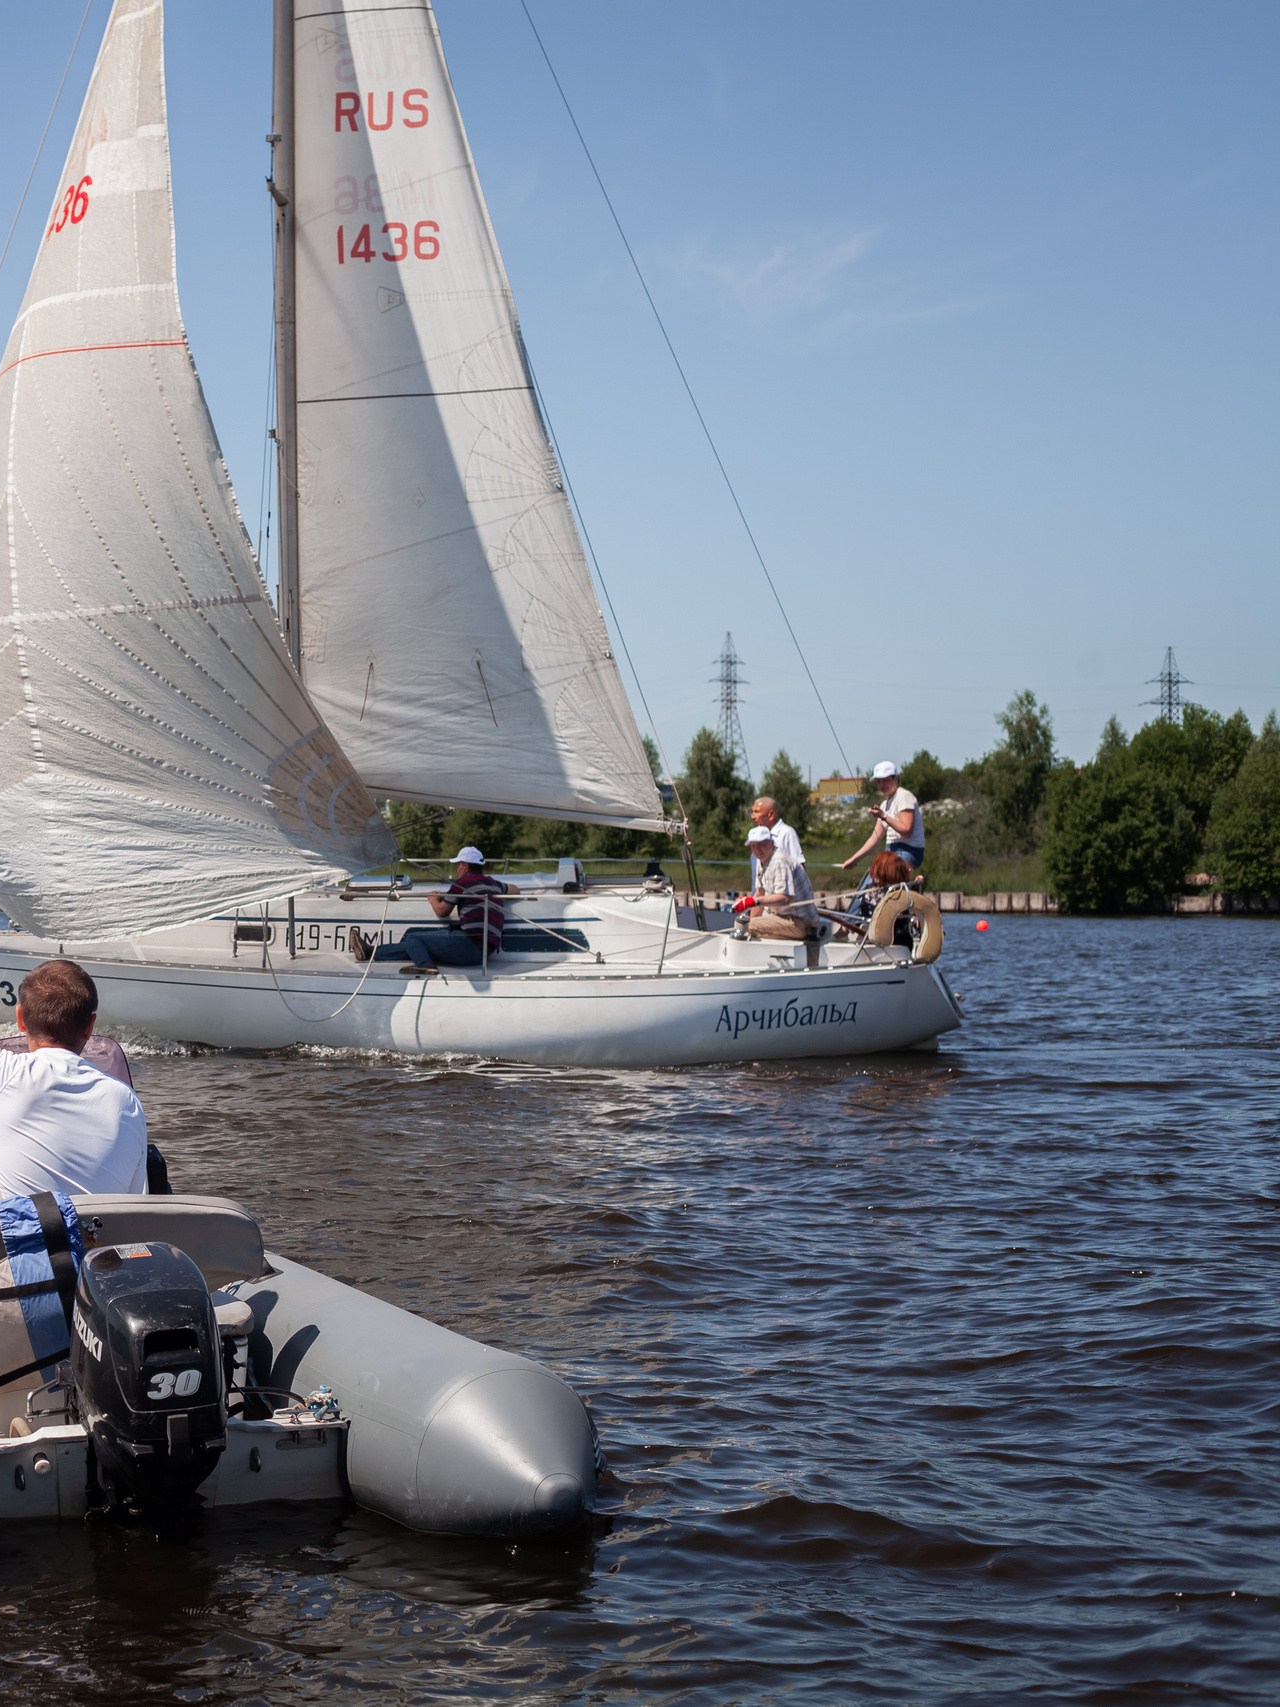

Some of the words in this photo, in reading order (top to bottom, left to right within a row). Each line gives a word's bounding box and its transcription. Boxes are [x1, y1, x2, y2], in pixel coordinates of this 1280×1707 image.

[335, 88, 429, 132] RUS
[336, 220, 440, 264] 1436
[715, 996, 858, 1040] Арчибальд
[146, 1369, 203, 1400] 30
